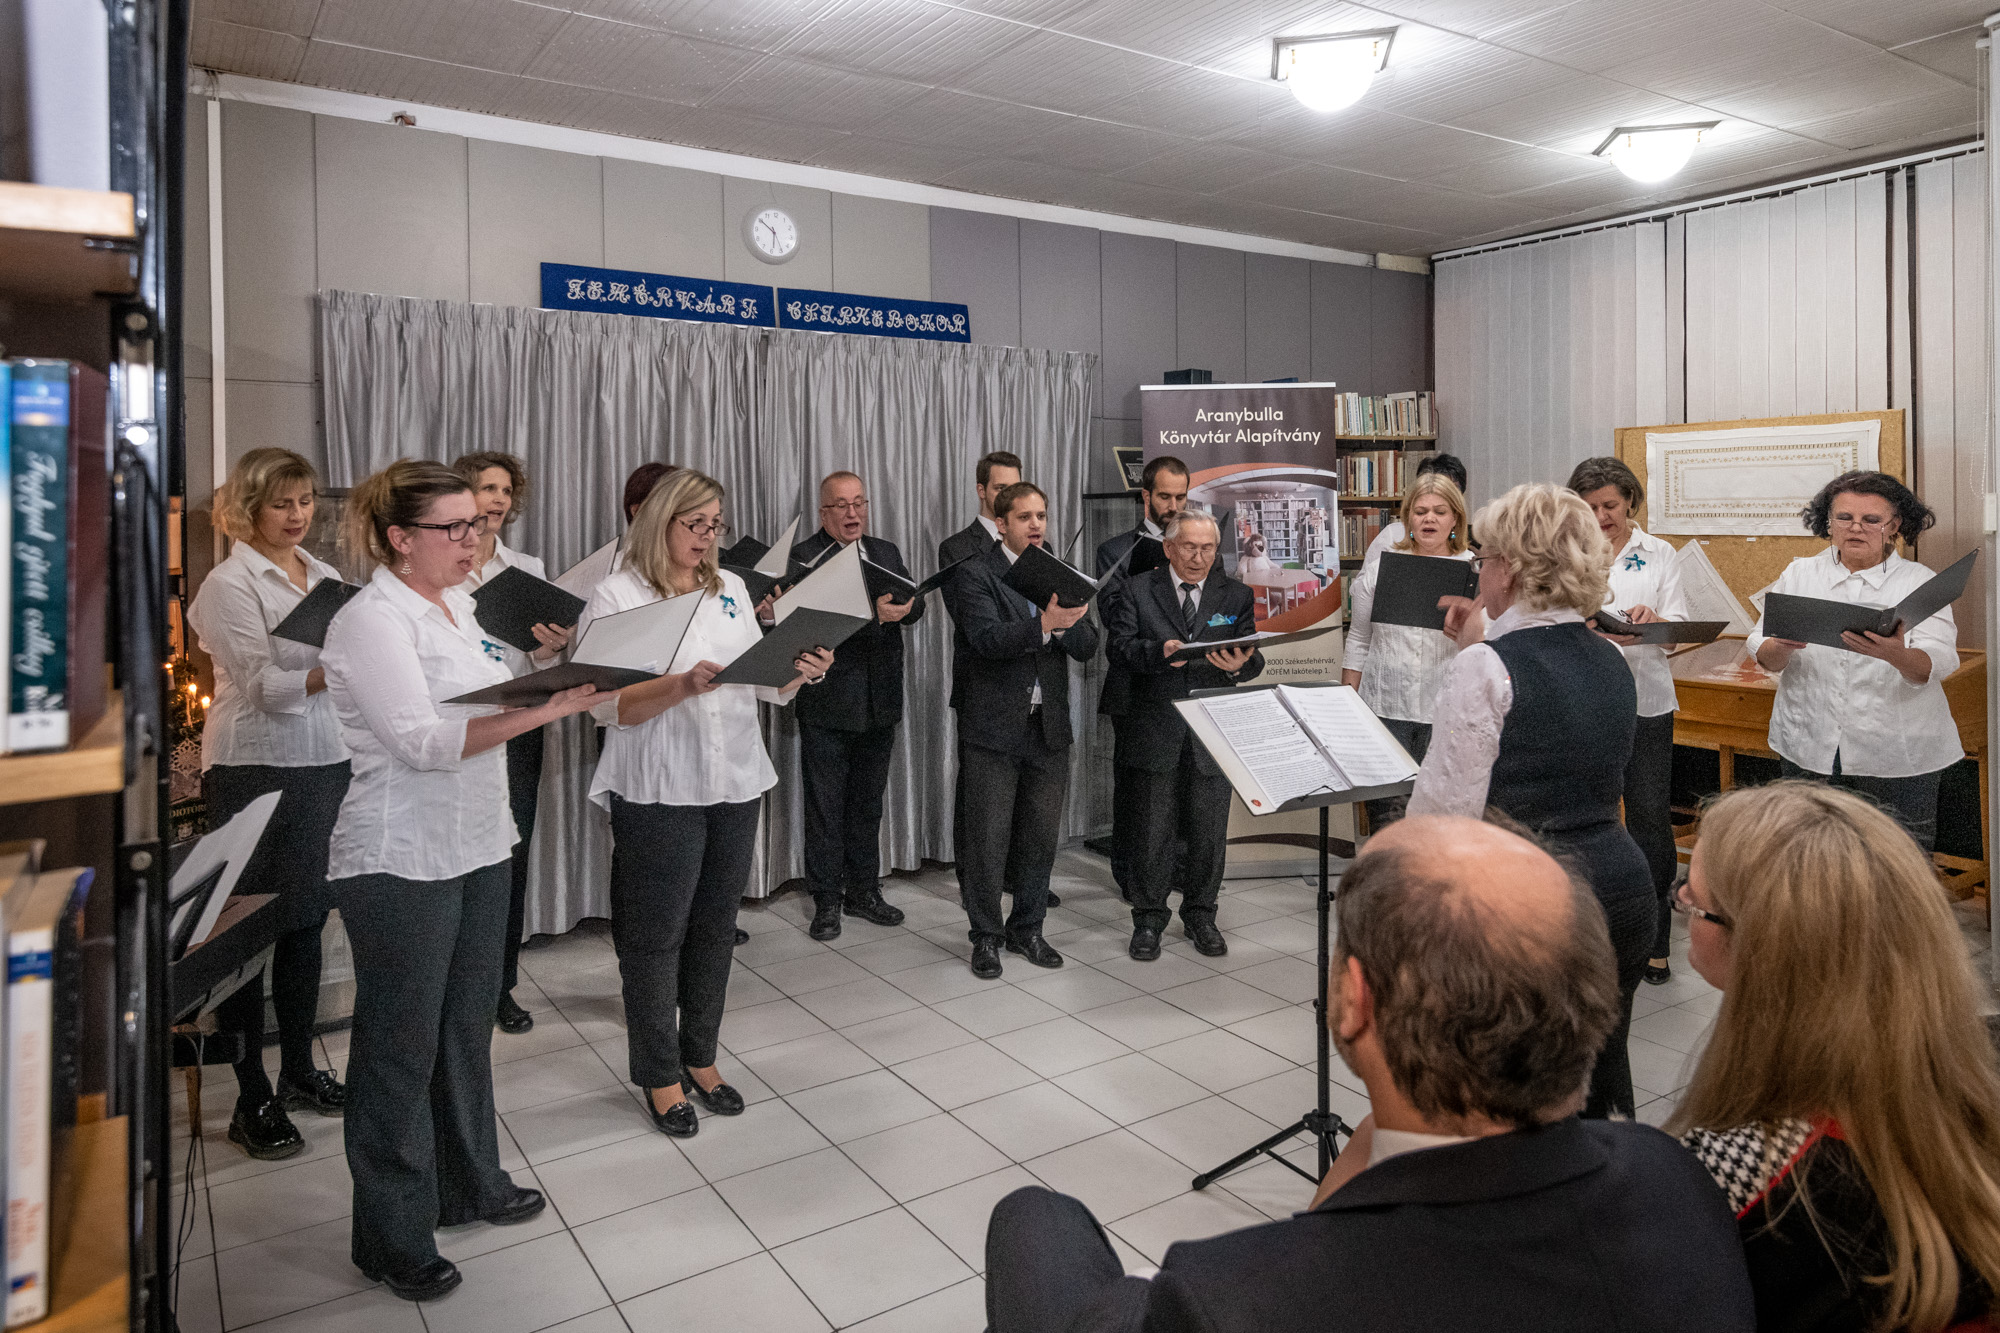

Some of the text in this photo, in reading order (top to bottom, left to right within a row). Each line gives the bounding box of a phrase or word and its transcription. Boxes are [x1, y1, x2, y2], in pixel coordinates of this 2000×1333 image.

[1195, 407, 1284, 425] Aranybulla
[1160, 428, 1321, 448] Könyvtár Alapítvány
[1266, 657, 1336, 666] 8000 Székesfehérvár,
[1266, 668, 1290, 676] KÖFÉM
[1291, 667, 1323, 675] lakótelep
